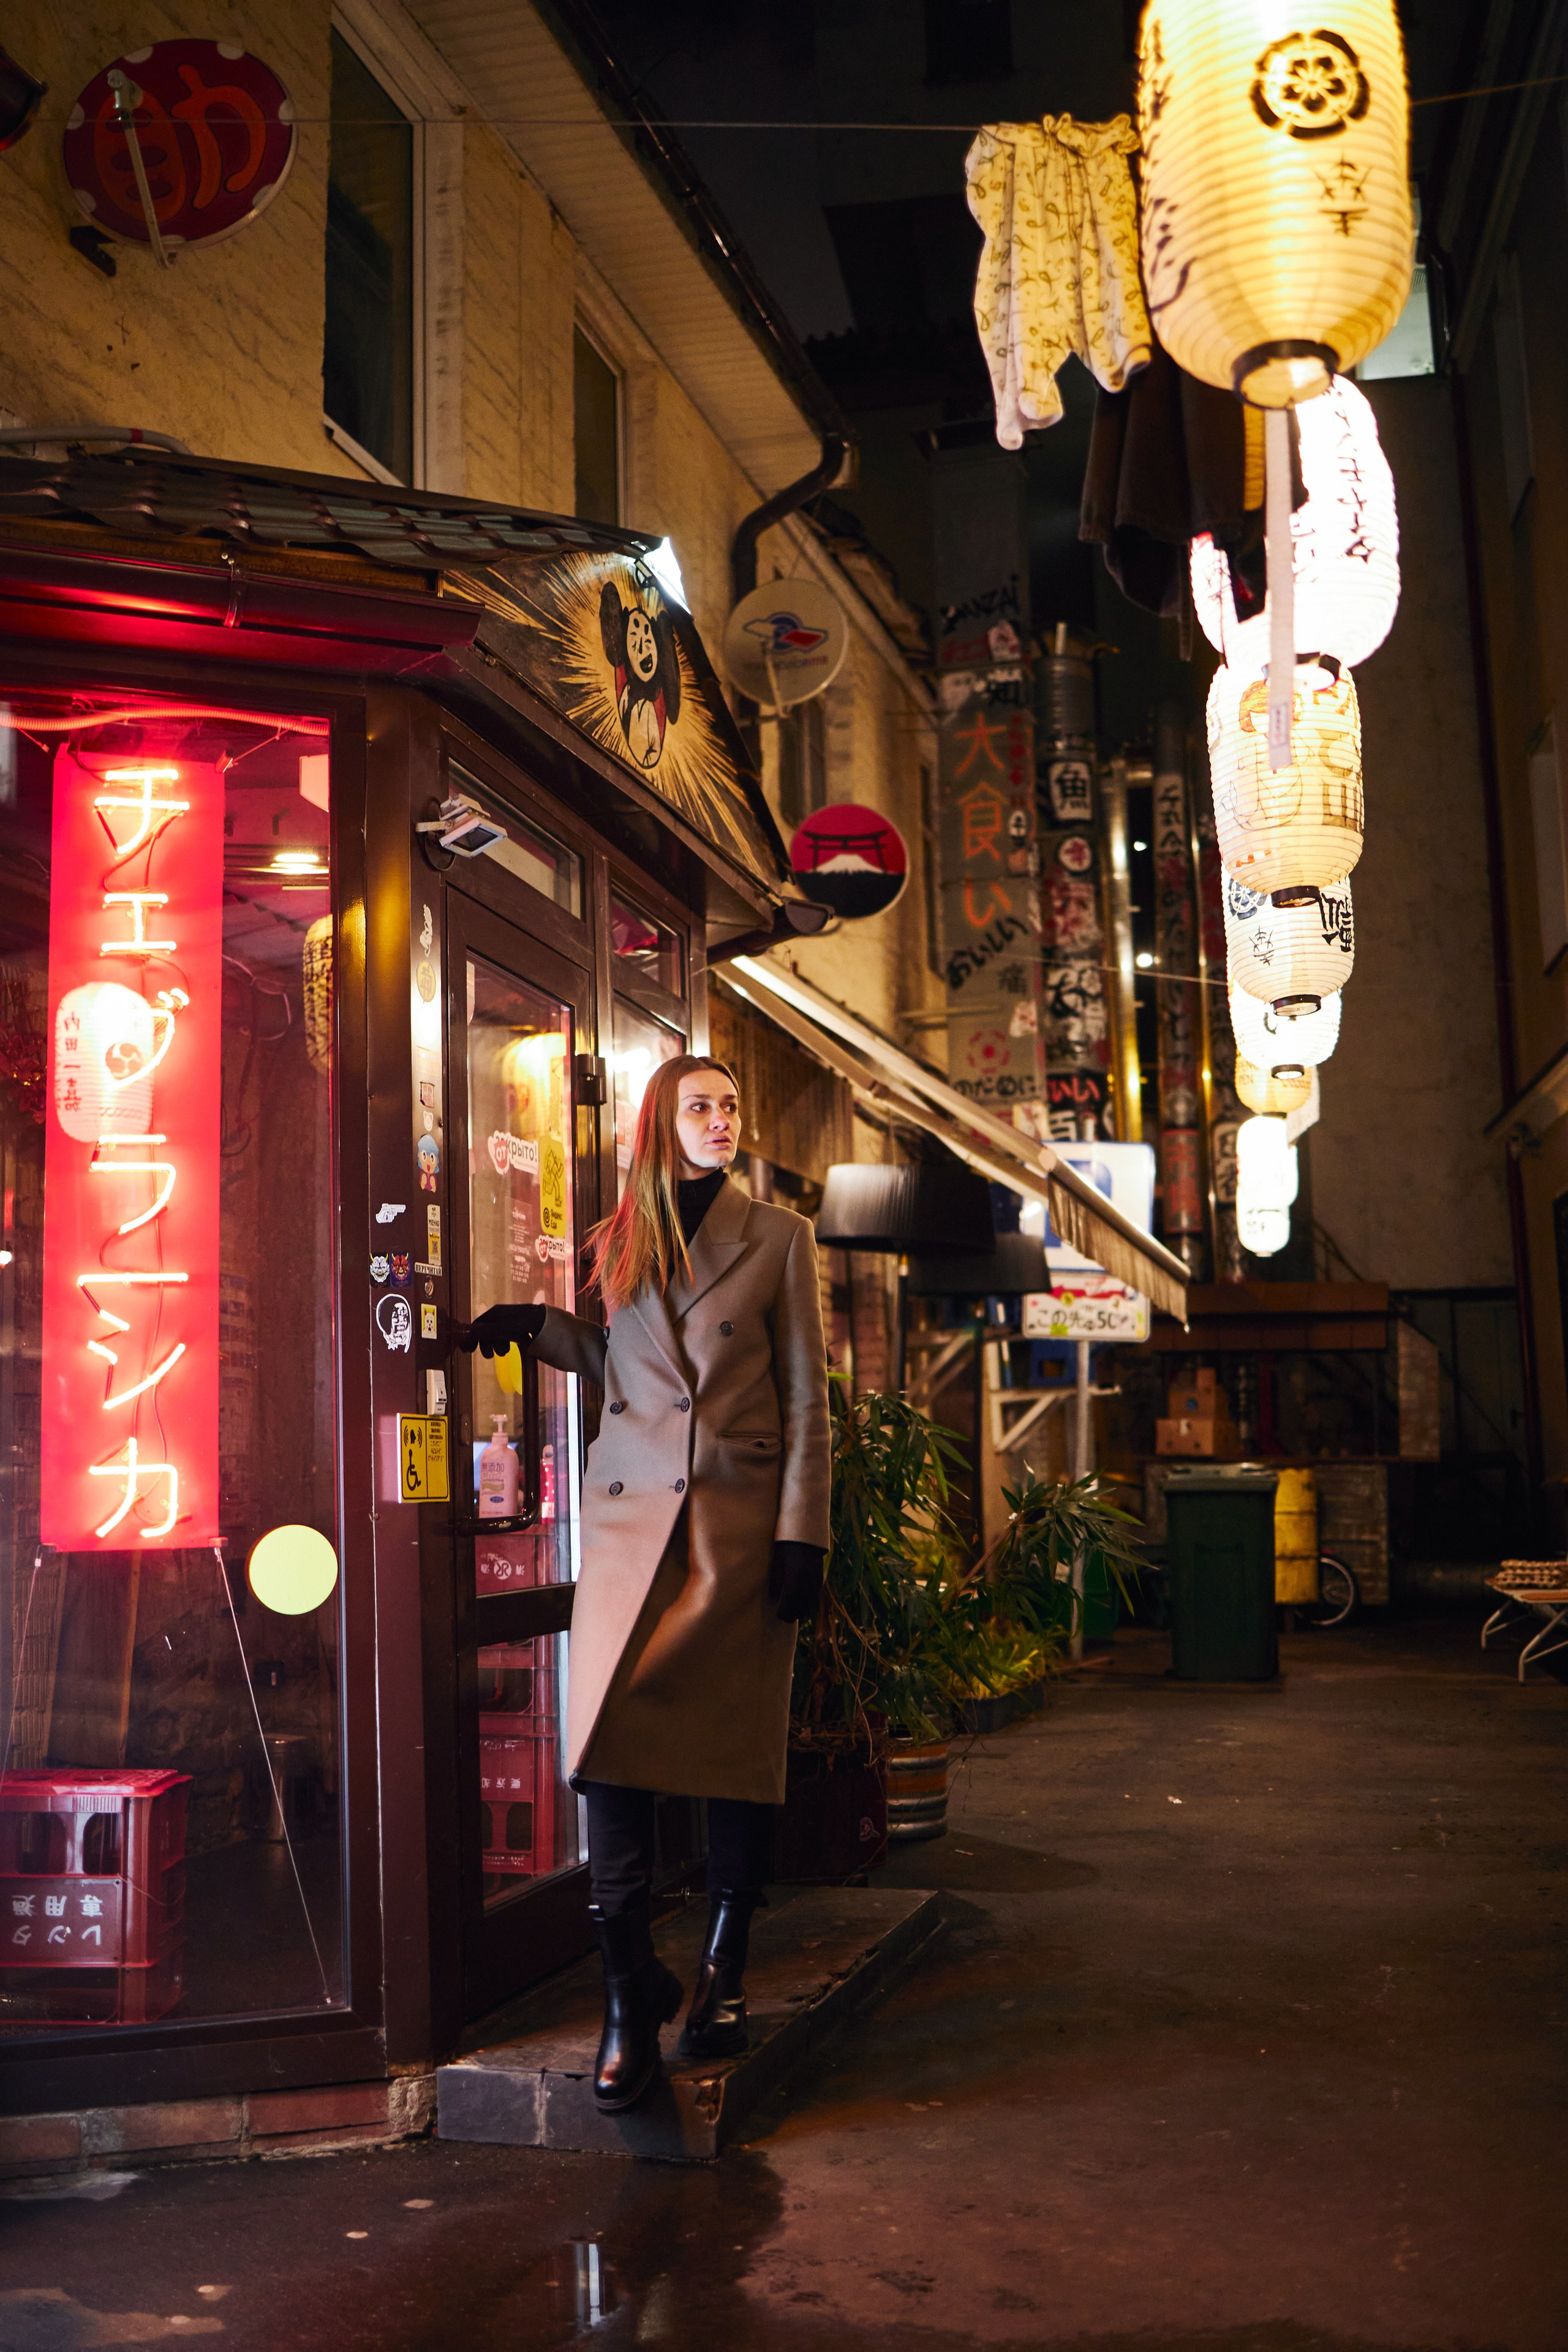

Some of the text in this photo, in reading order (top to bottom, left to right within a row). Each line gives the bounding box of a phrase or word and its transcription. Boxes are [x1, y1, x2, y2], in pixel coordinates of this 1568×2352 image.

[955, 712, 1011, 928] 大食い
[428, 1218, 440, 1227] МЕНЮ
[415, 1264, 442, 1276] ПЕРЕЧИТАЙ
